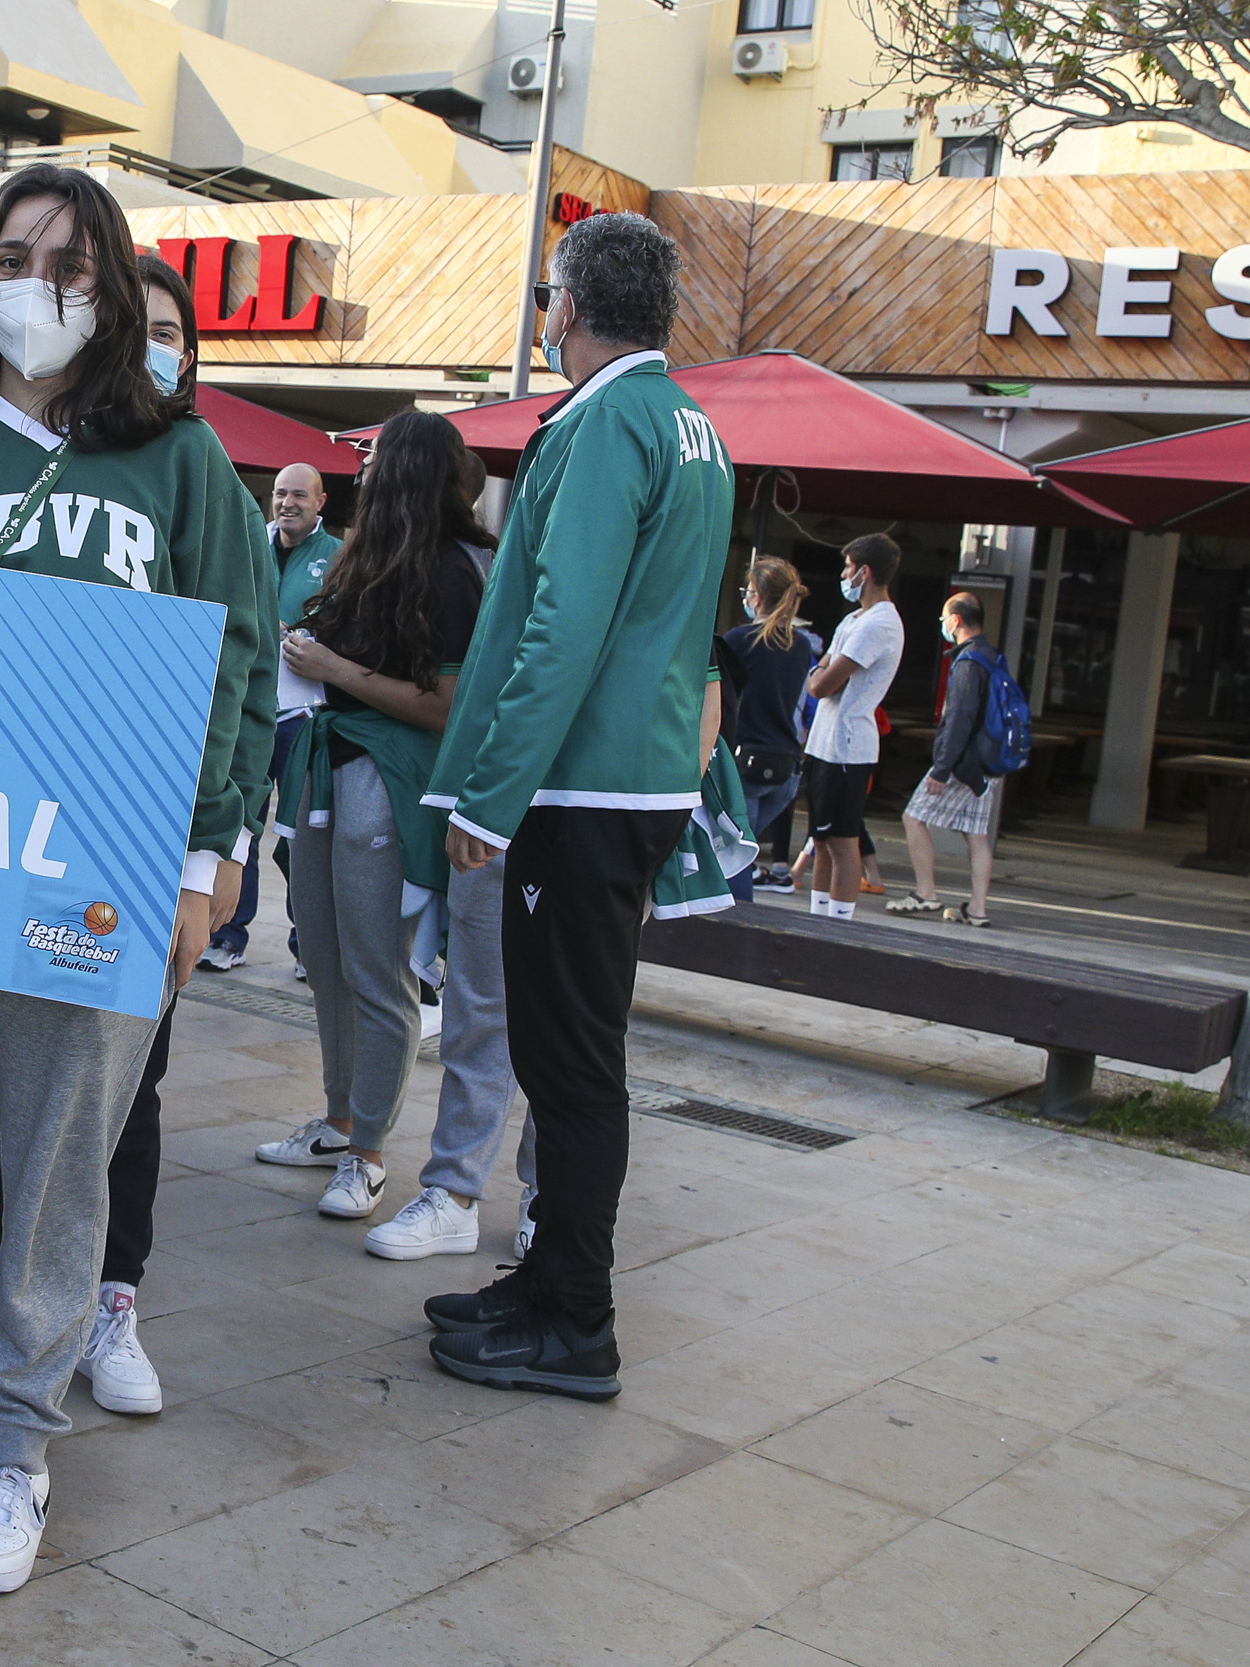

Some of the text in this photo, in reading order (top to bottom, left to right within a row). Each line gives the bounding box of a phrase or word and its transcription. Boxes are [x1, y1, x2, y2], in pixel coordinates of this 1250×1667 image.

[39, 469, 53, 481] CA
[0, 526, 15, 539] CA
[21, 918, 96, 948] Festa do
[27, 935, 120, 964] Basquetebol
[49, 957, 99, 974] Albufeira
